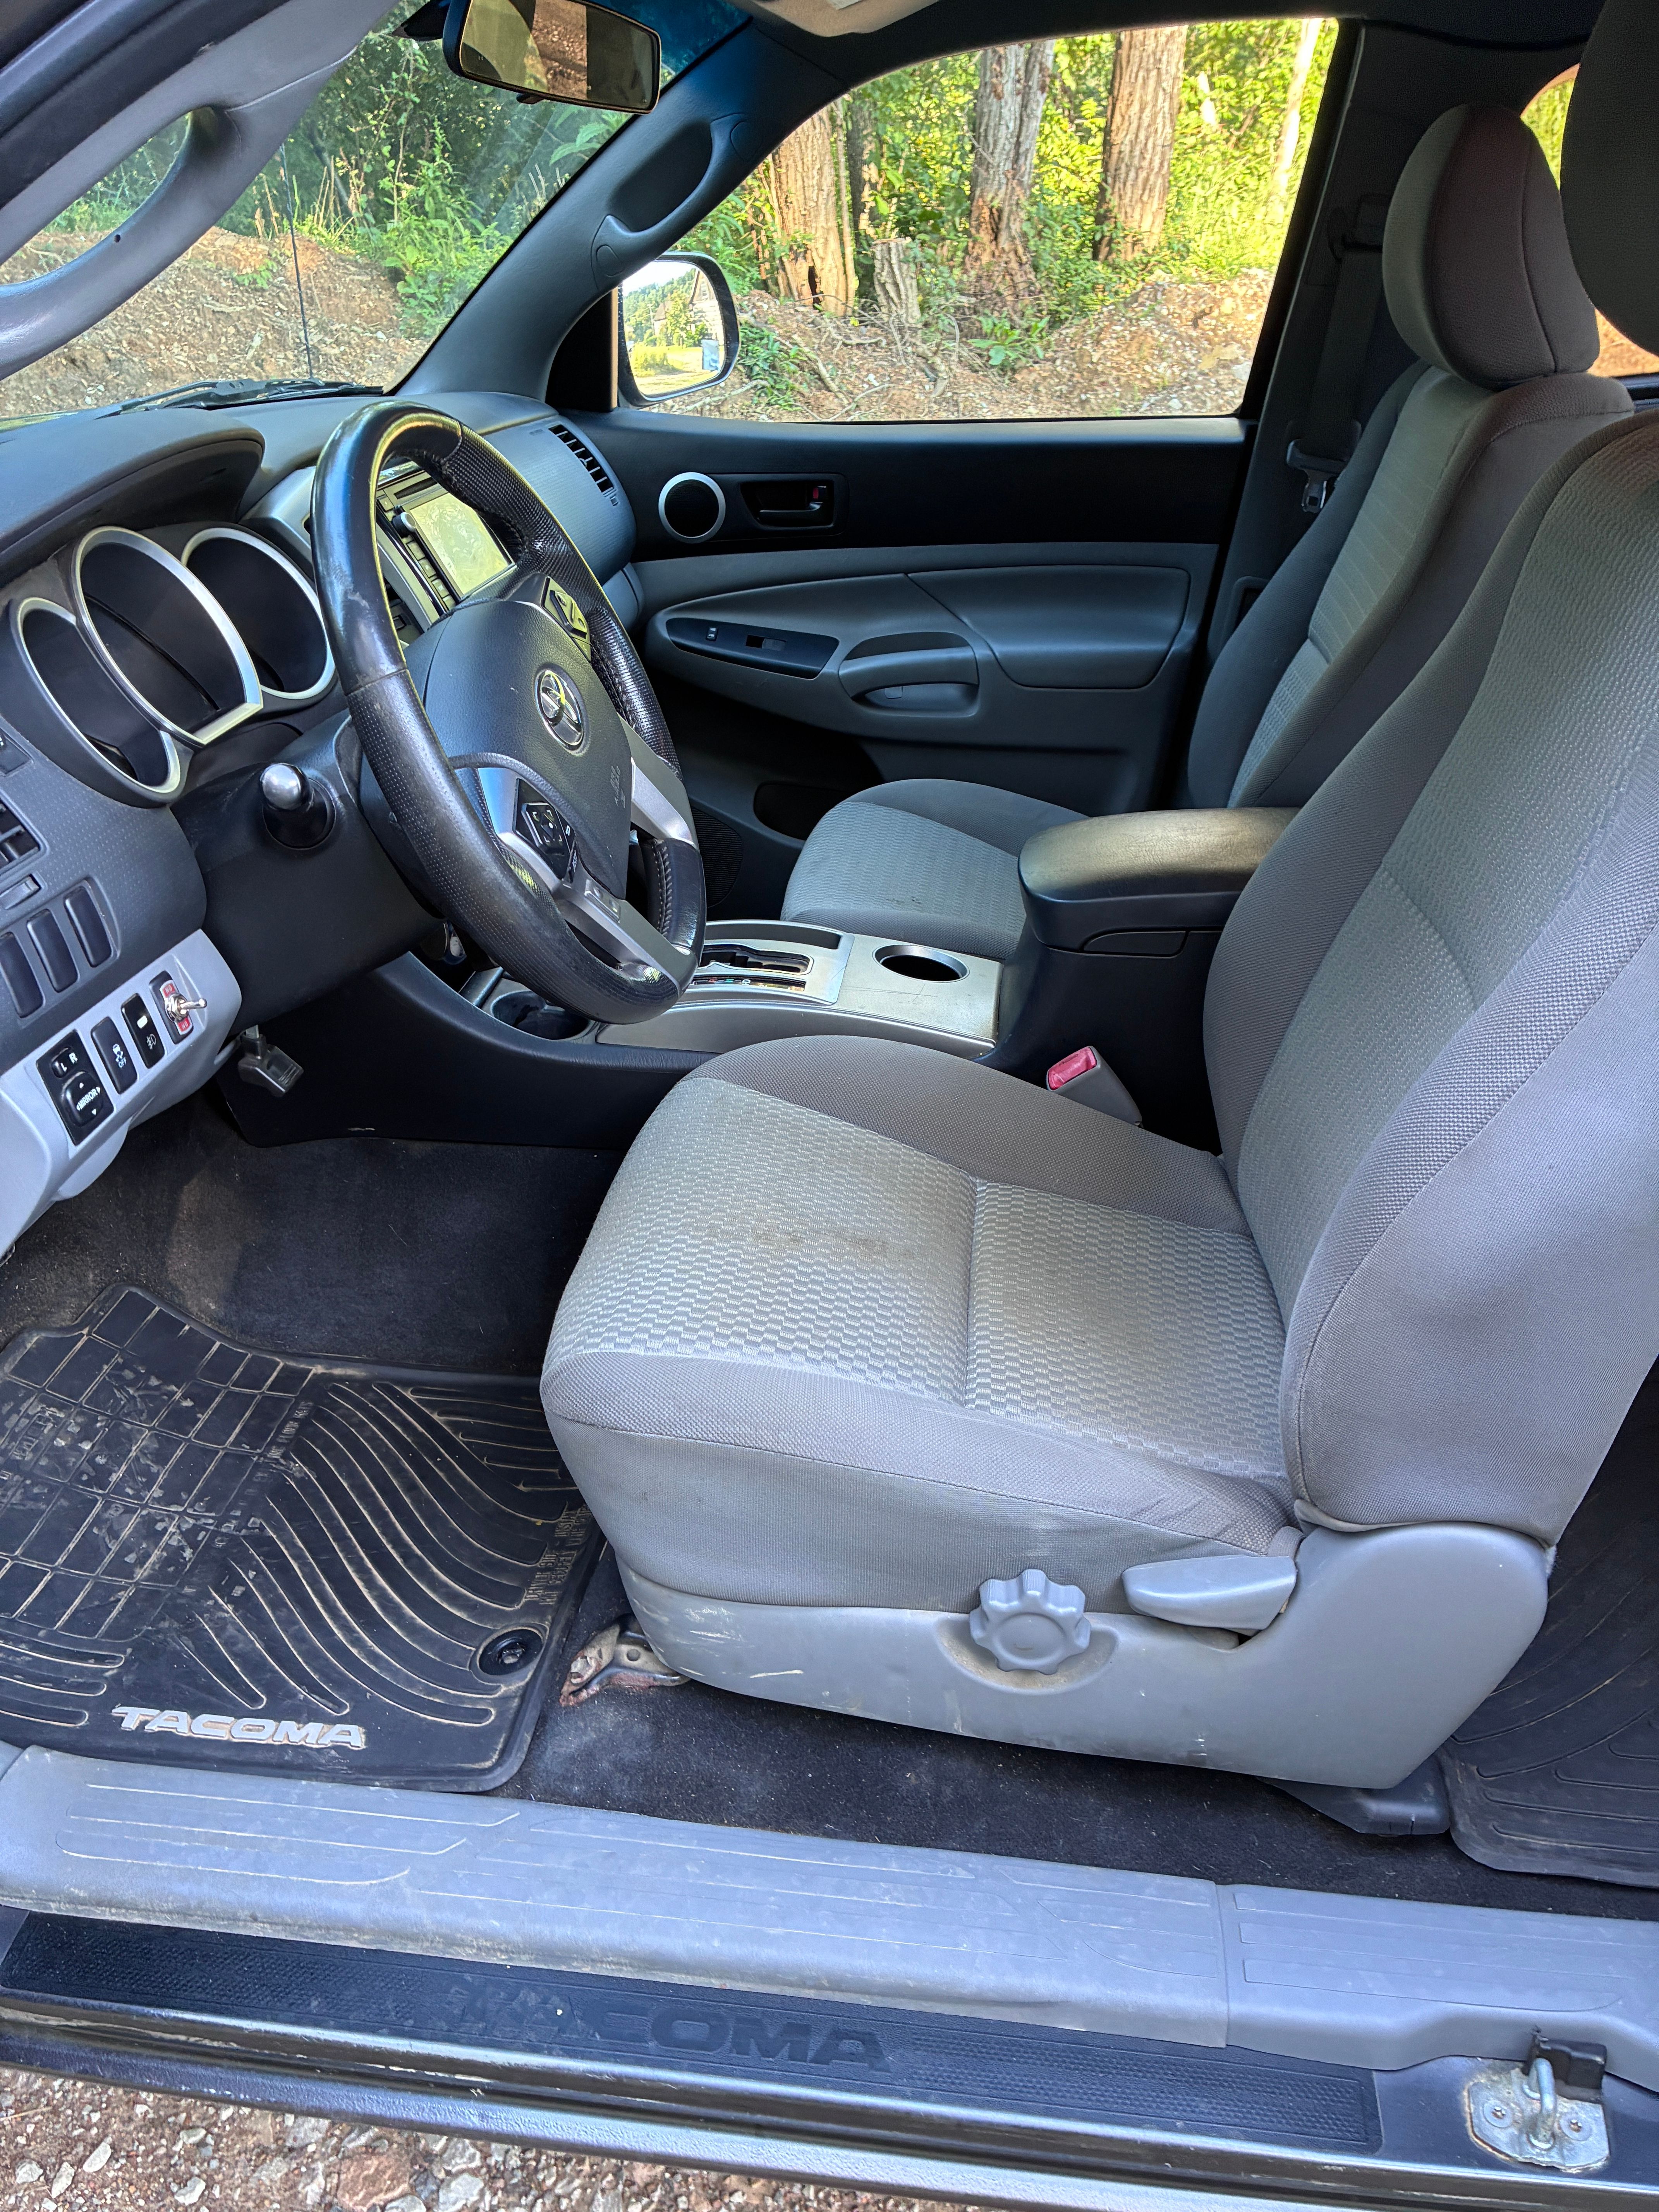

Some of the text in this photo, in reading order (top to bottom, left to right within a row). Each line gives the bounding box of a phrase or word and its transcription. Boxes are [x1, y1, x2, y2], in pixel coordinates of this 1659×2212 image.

[60, 1053, 77, 1072] L R
[118, 1057, 127, 1068] OFF
[78, 1089, 98, 1109] MIRROR
[112, 1705, 364, 1748] TACOMA
